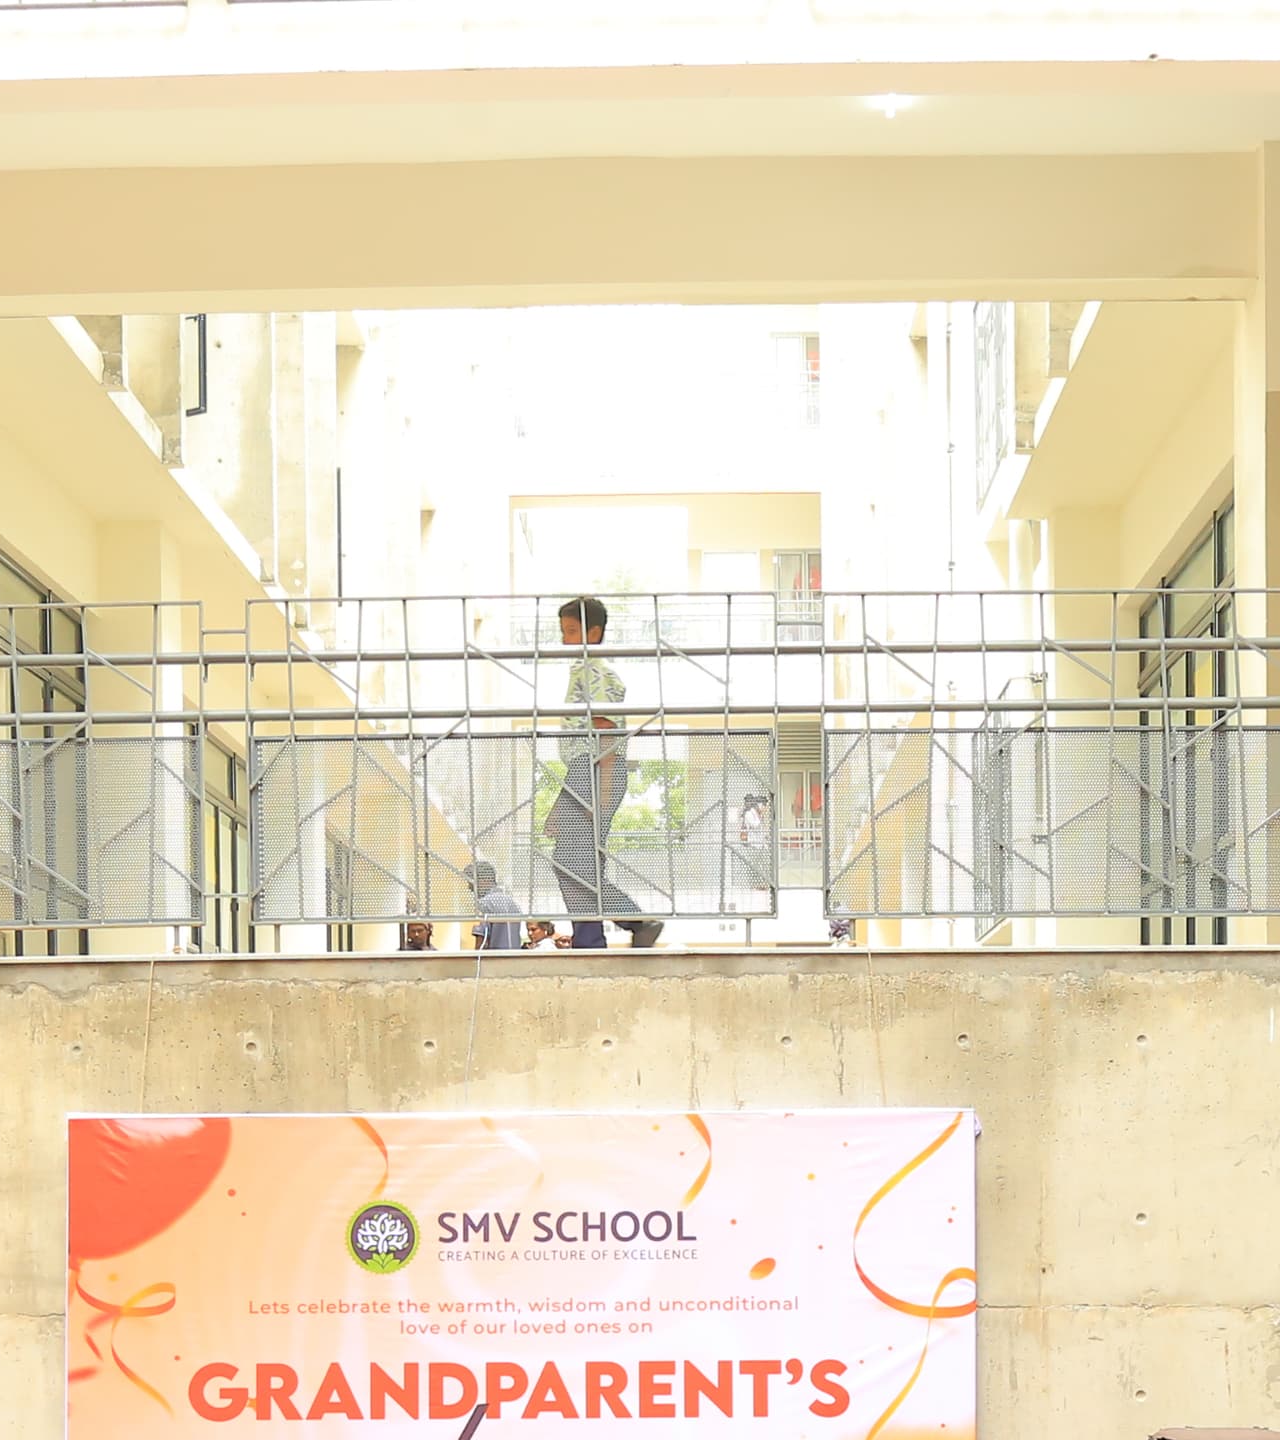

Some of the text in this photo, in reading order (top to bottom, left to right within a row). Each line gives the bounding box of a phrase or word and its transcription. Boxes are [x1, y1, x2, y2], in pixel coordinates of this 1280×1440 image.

[437, 1210, 697, 1243] SMV SCHOOL
[437, 1249, 698, 1262] CREATING A CULTURE OF EXCELLENCE
[248, 1296, 799, 1315] Lets celebrate the warmth, wisdom and unconditional
[400, 1319, 653, 1335] love of our loved ones on
